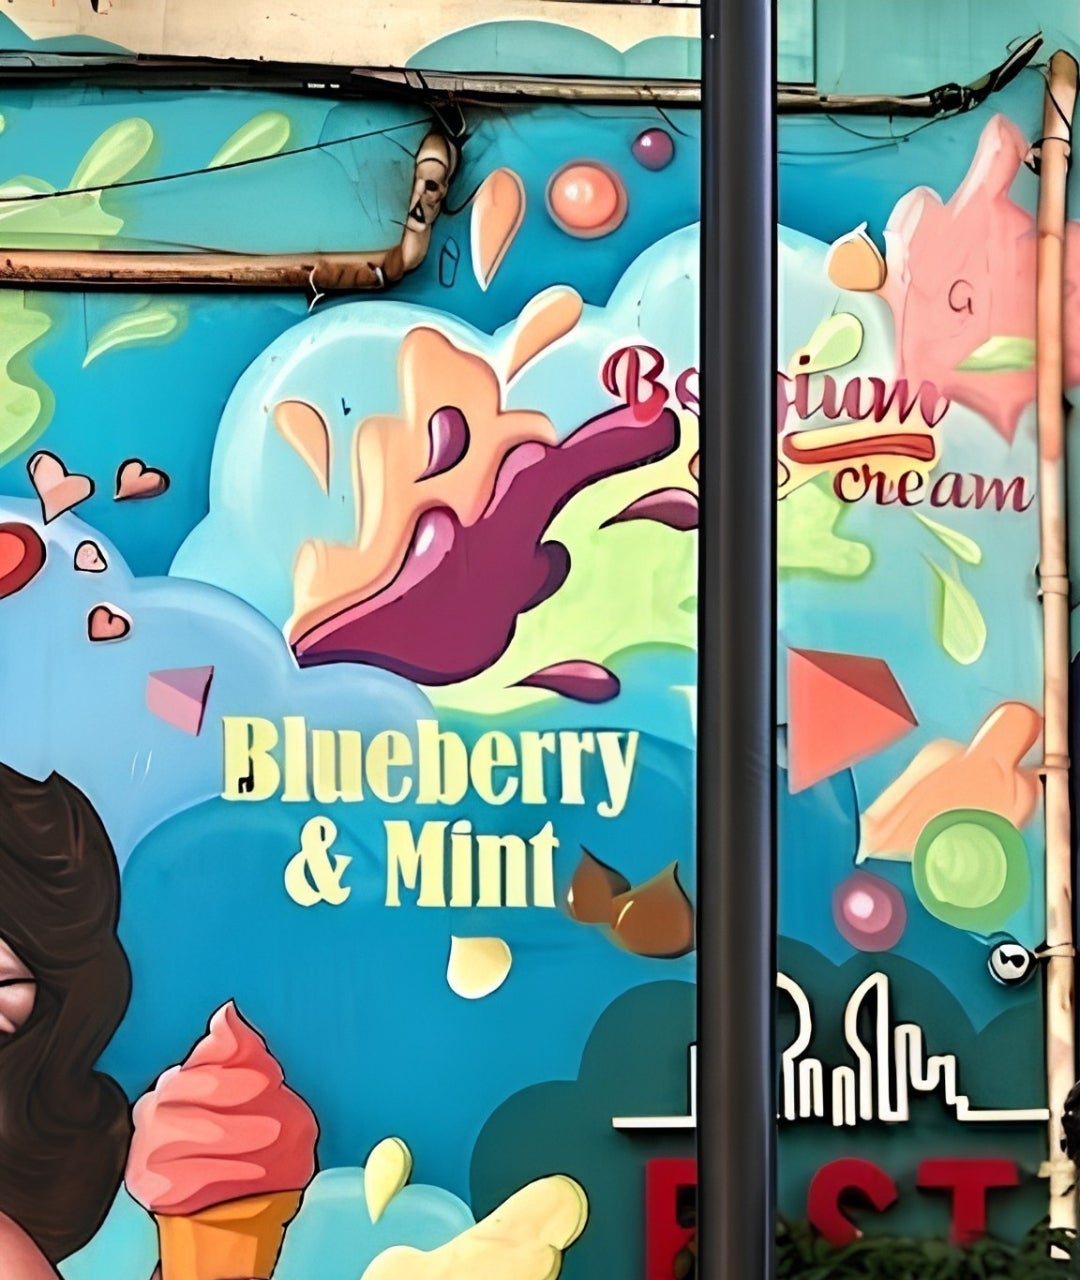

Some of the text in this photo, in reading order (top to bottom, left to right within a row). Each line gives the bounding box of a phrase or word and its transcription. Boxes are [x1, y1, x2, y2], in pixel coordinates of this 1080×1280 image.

[832, 463, 1036, 513] cream
[221, 715, 640, 819] Blueberry
[284, 815, 560, 909] & Mint
